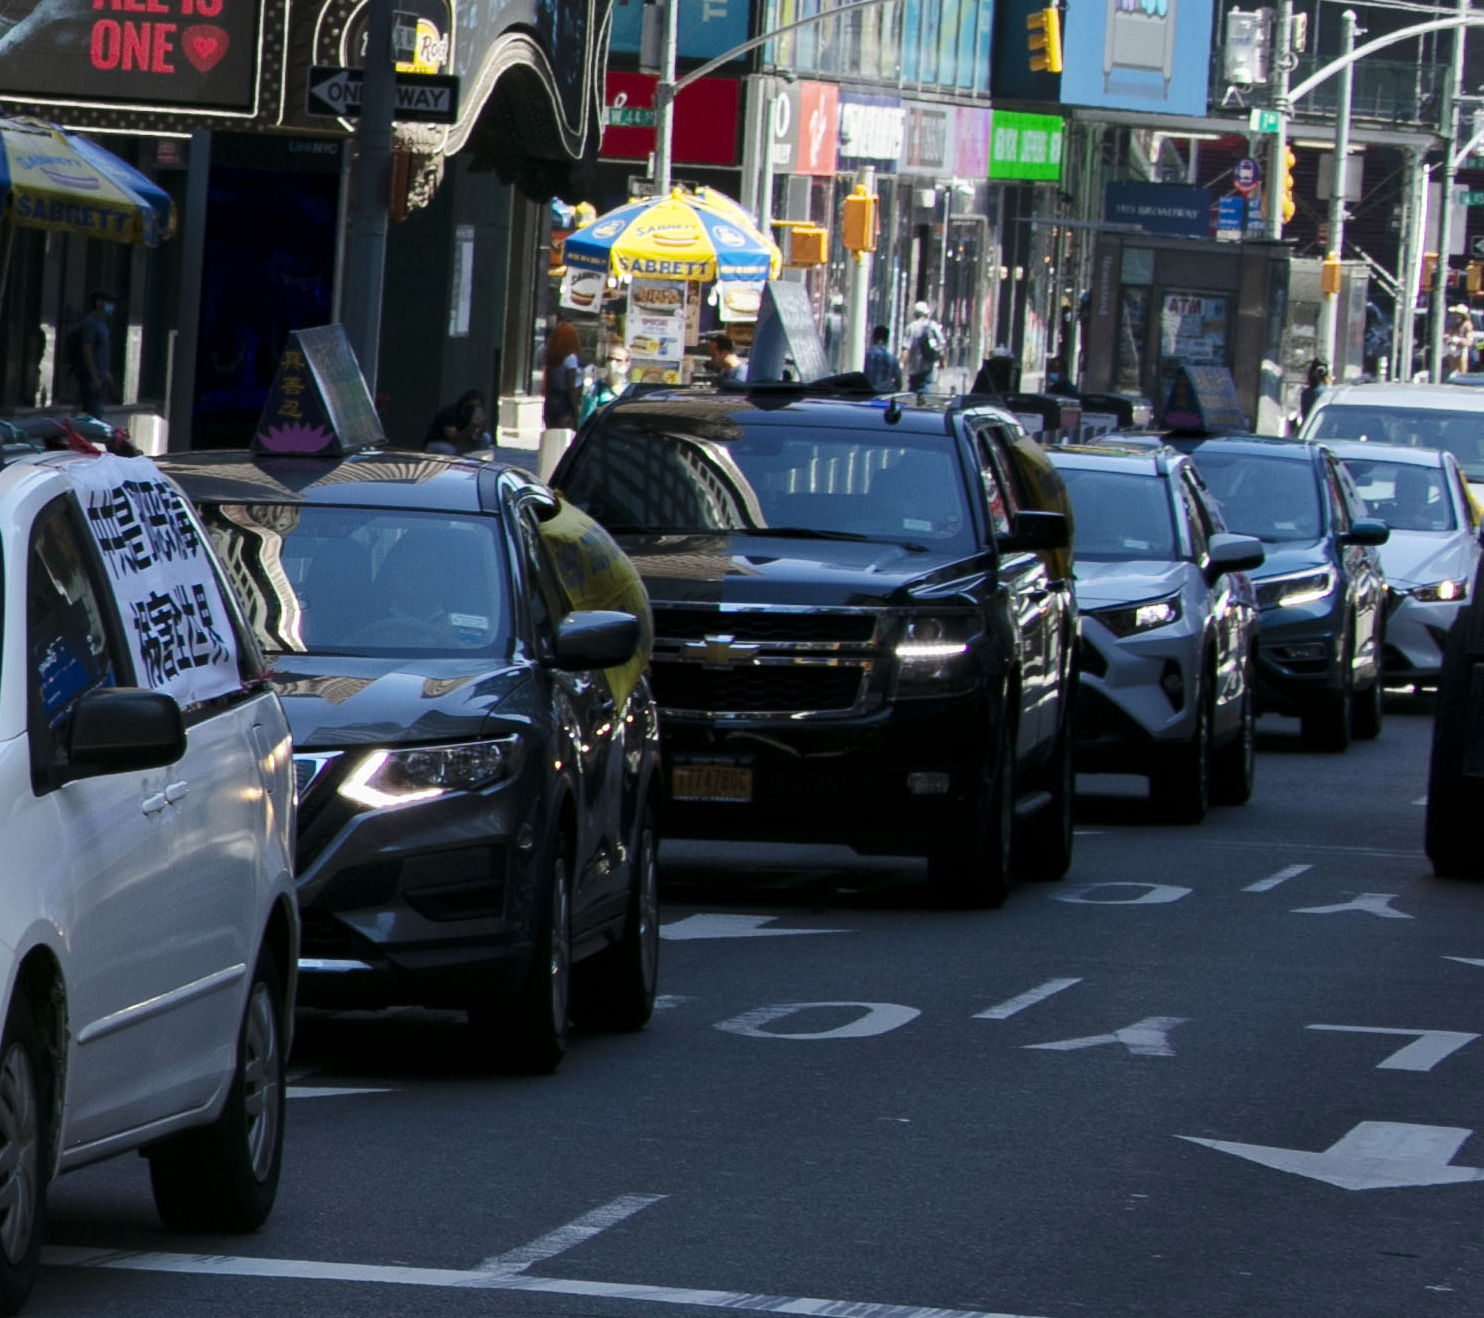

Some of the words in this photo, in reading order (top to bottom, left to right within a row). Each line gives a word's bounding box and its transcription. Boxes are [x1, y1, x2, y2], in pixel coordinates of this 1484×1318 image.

[89, 18, 177, 73] ONE
[398, 87, 445, 108] WAY
[15, 194, 130, 233] SABRETT
[1137, 205, 1200, 219] BROADWAY
[618, 255, 710, 277] SABRETT
[1167, 296, 1203, 316] ATM
